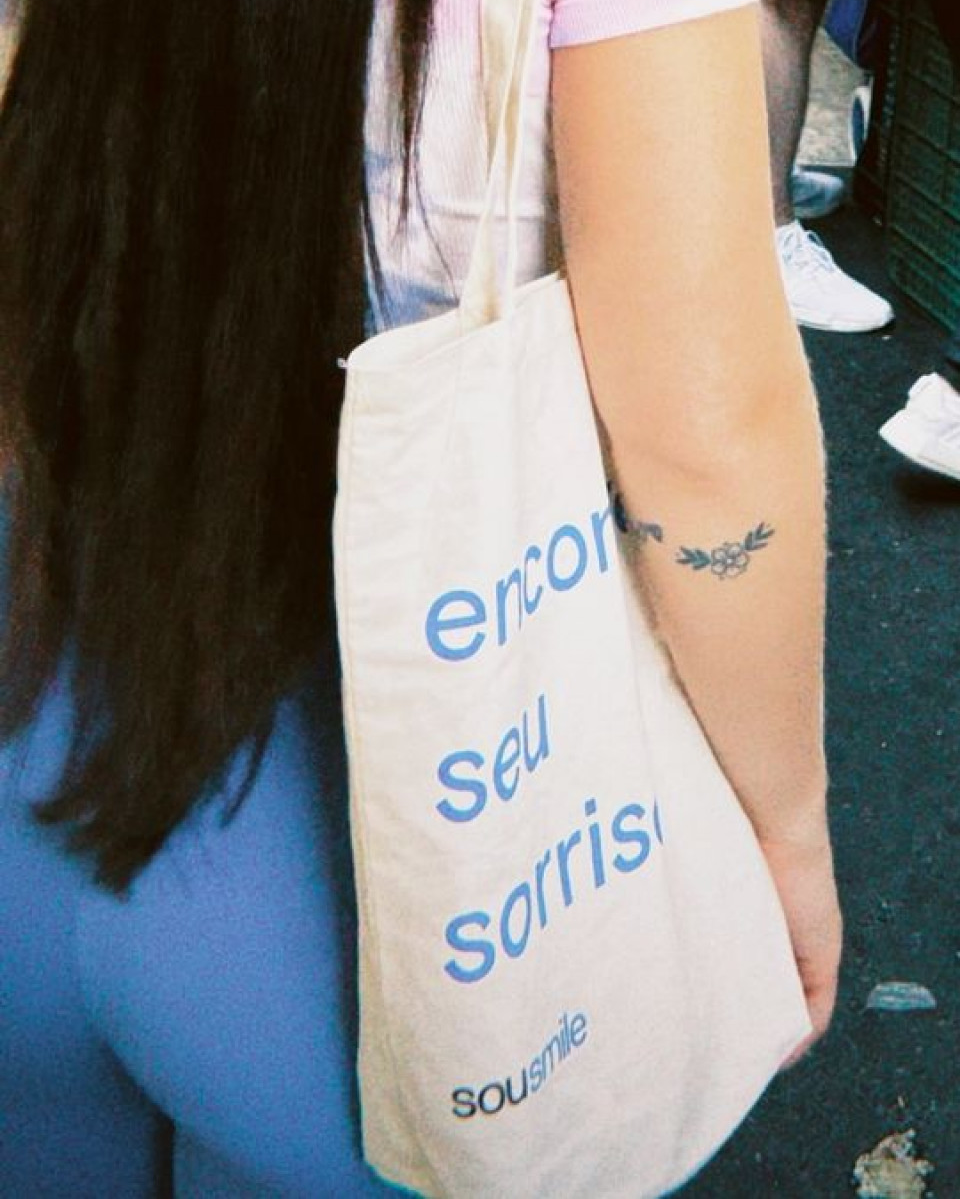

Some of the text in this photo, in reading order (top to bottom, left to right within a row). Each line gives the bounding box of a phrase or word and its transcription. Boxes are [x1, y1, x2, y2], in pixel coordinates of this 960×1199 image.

[435, 693, 550, 824] seu
[443, 795, 664, 985] sorris
[452, 1012, 588, 1118] sousmile
